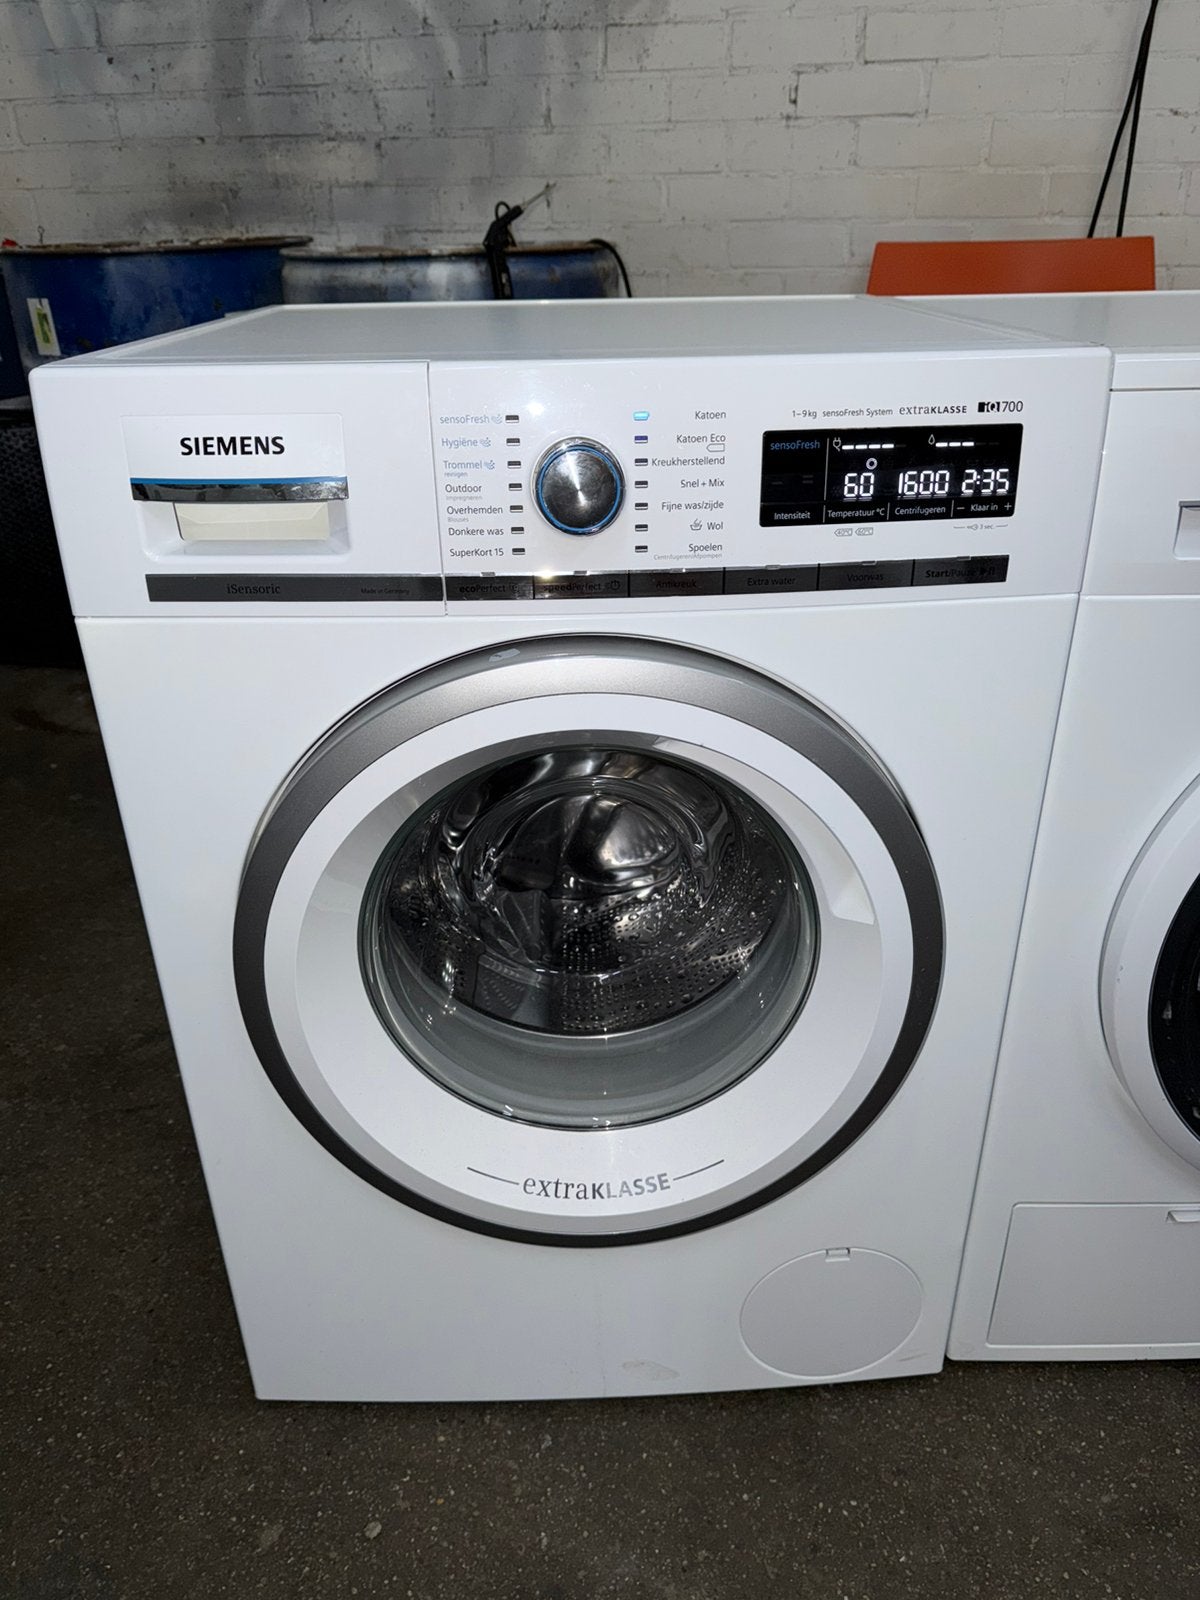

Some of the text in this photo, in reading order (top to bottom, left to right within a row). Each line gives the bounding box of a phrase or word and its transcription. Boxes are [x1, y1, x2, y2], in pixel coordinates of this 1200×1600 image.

[694, 410, 727, 420] Katoen
[822, 408, 864, 418] sensoFresh
[866, 407, 893, 418] System
[899, 405, 967, 416] extraKLASSE
[440, 414, 490, 424] sensoFresh
[441, 437, 478, 449] Hygiëne
[676, 433, 726, 444] Katoen Eco
[180, 435, 286, 457] SIEMENS
[770, 440, 821, 450] sensoFresh
[443, 460, 483, 470] Trommel
[651, 456, 726, 467] Kreukherstellend
[680, 478, 700, 488] Snel
[708, 477, 725, 487] Mix
[843, 472, 875, 497] 60
[898, 470, 950, 495] 1600
[961, 468, 1010, 493] 2:35
[445, 483, 482, 493] Outdoor
[446, 505, 504, 515] Overhemden
[661, 500, 725, 512] Fijne was/zijde
[894, 506, 946, 516] Centrifugeren
[970, 503, 989, 512] Klaar
[990, 502, 999, 511] in
[774, 511, 811, 520] Intensiteit
[827, 509, 875, 519] Temperatuur
[707, 521, 724, 531] Wol
[448, 527, 504, 536] Donkere was
[449, 547, 505, 558] SuperKort 15
[688, 543, 723, 553] Spoelen
[747, 577, 796, 587] Extra water
[847, 572, 884, 582] Voorwas
[226, 583, 281, 594] iSensoric
[459, 583, 506, 594] ecoPerfect
[655, 579, 698, 590] Antikreuk
[522, 1172, 672, 1200] extraKLASSE
